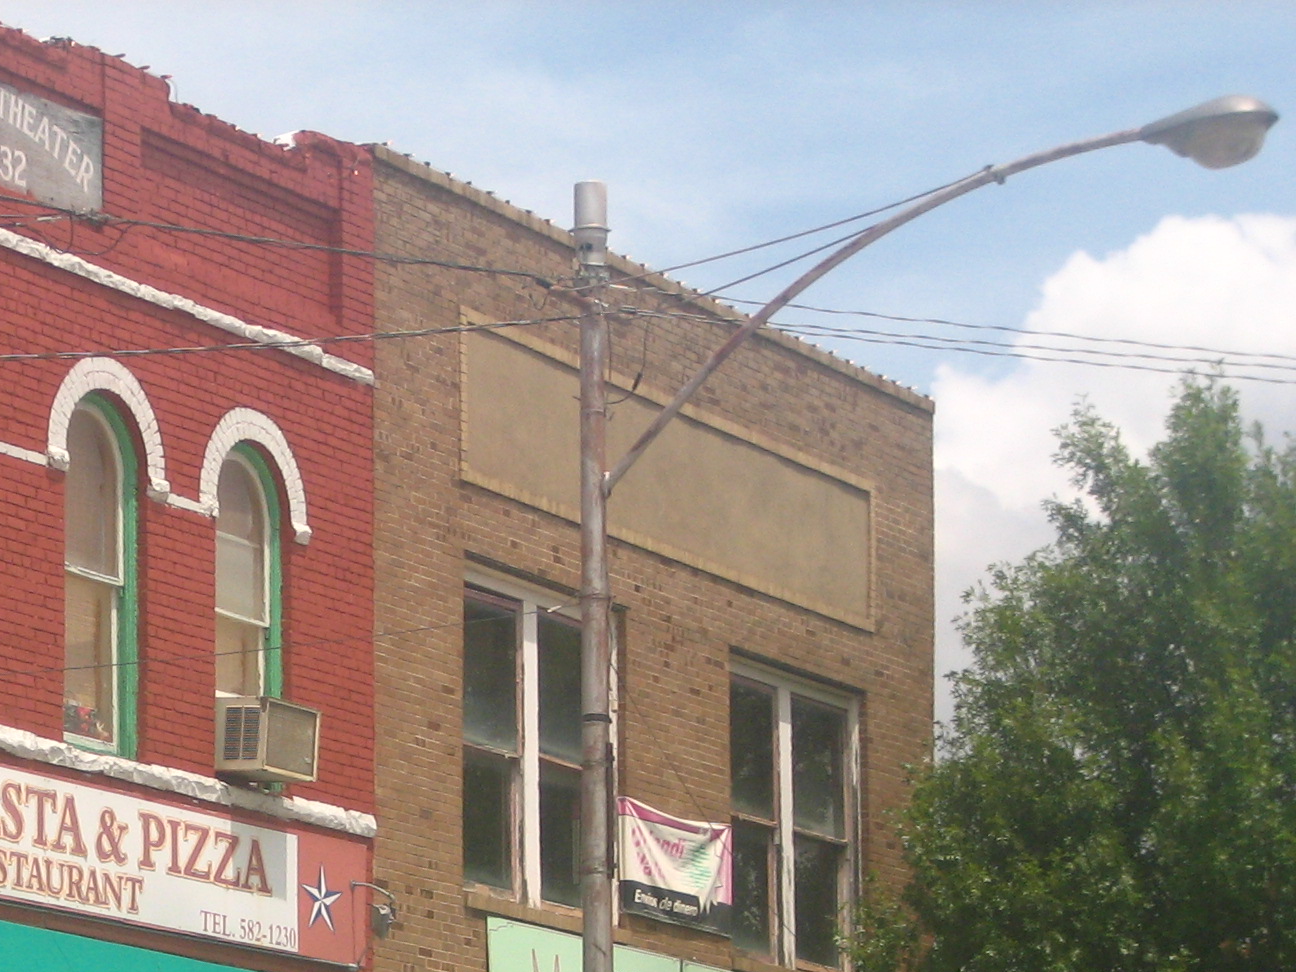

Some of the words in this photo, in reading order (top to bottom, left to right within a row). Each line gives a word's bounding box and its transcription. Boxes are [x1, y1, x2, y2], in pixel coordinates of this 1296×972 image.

[95, 806, 129, 865] &
[138, 809, 273, 897] PIZZA
[200, 910, 235, 937] TEL.
[239, 920, 297, 950] 582-1230
